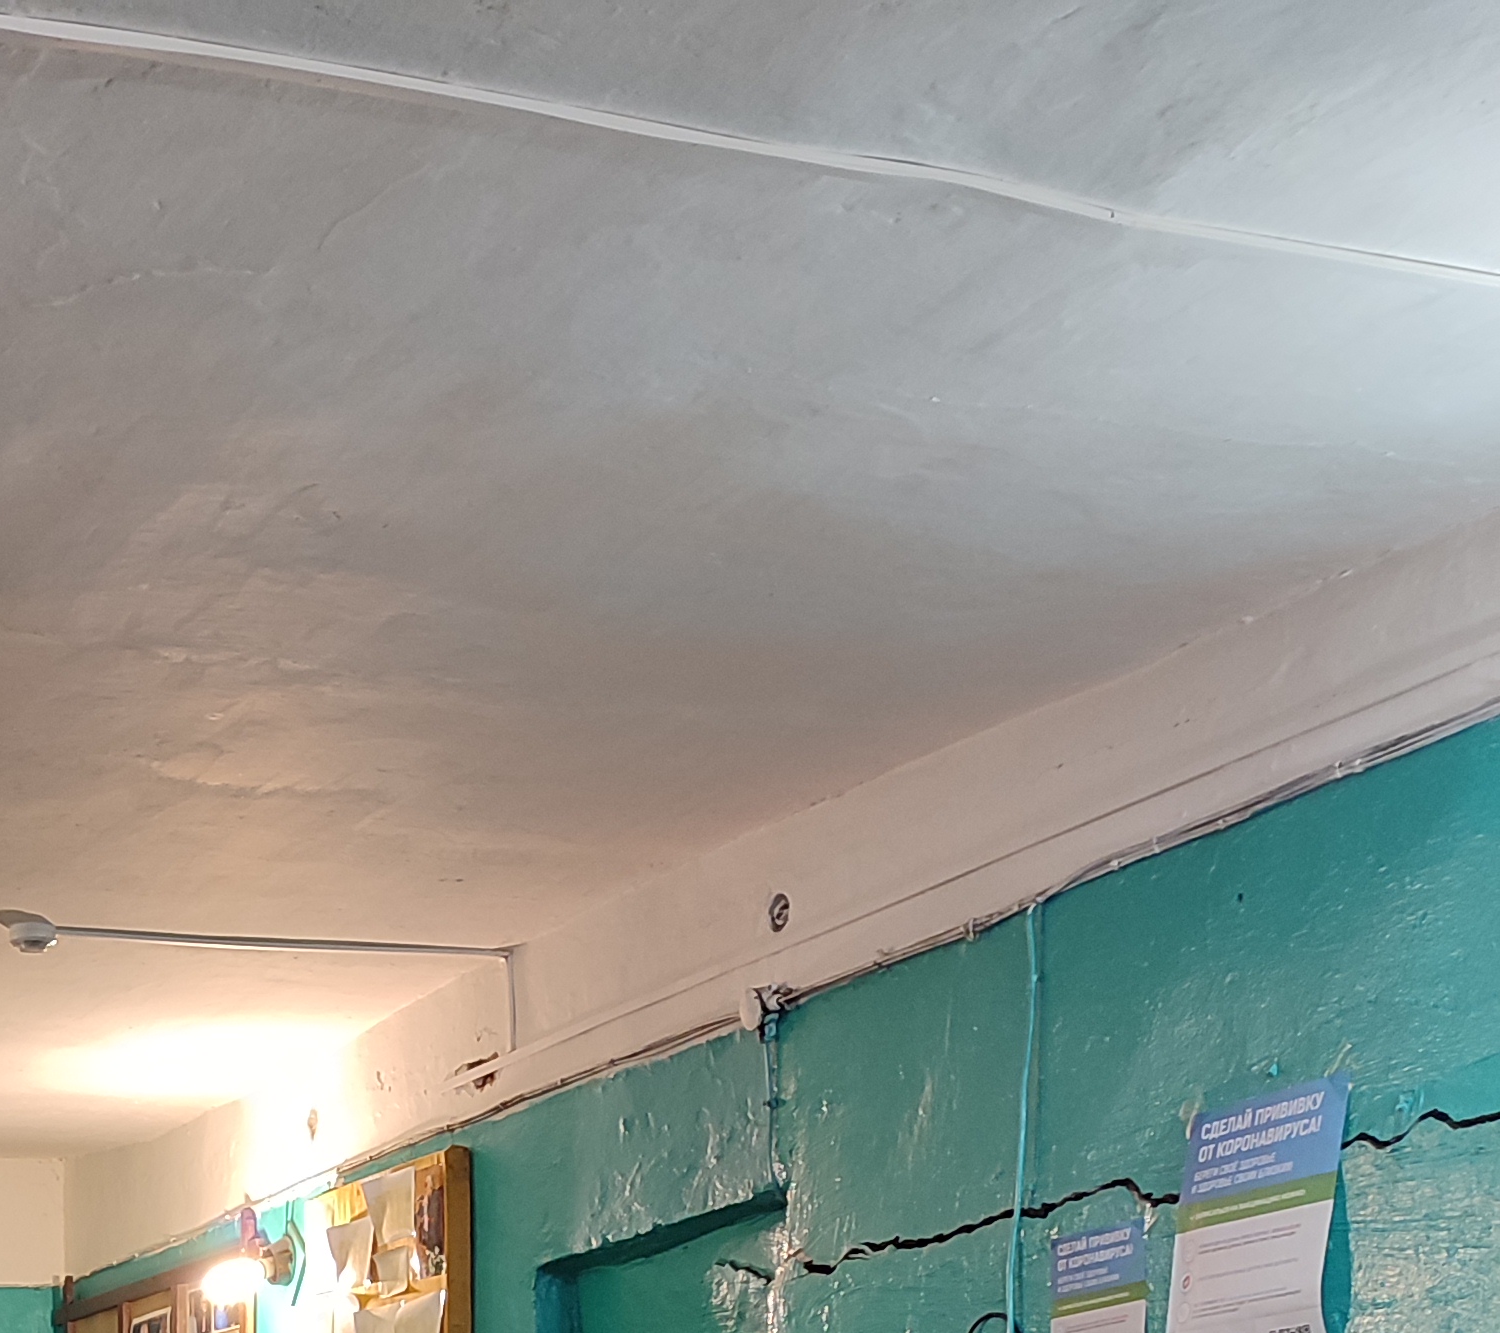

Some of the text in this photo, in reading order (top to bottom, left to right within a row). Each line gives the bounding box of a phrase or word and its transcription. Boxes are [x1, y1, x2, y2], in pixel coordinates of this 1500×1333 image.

[1198, 1115, 1323, 1163] ОТ КОРОНАВИРУСА!
[1200, 1091, 1325, 1141] СДЕЛАЙ ПРИВИВКУ
